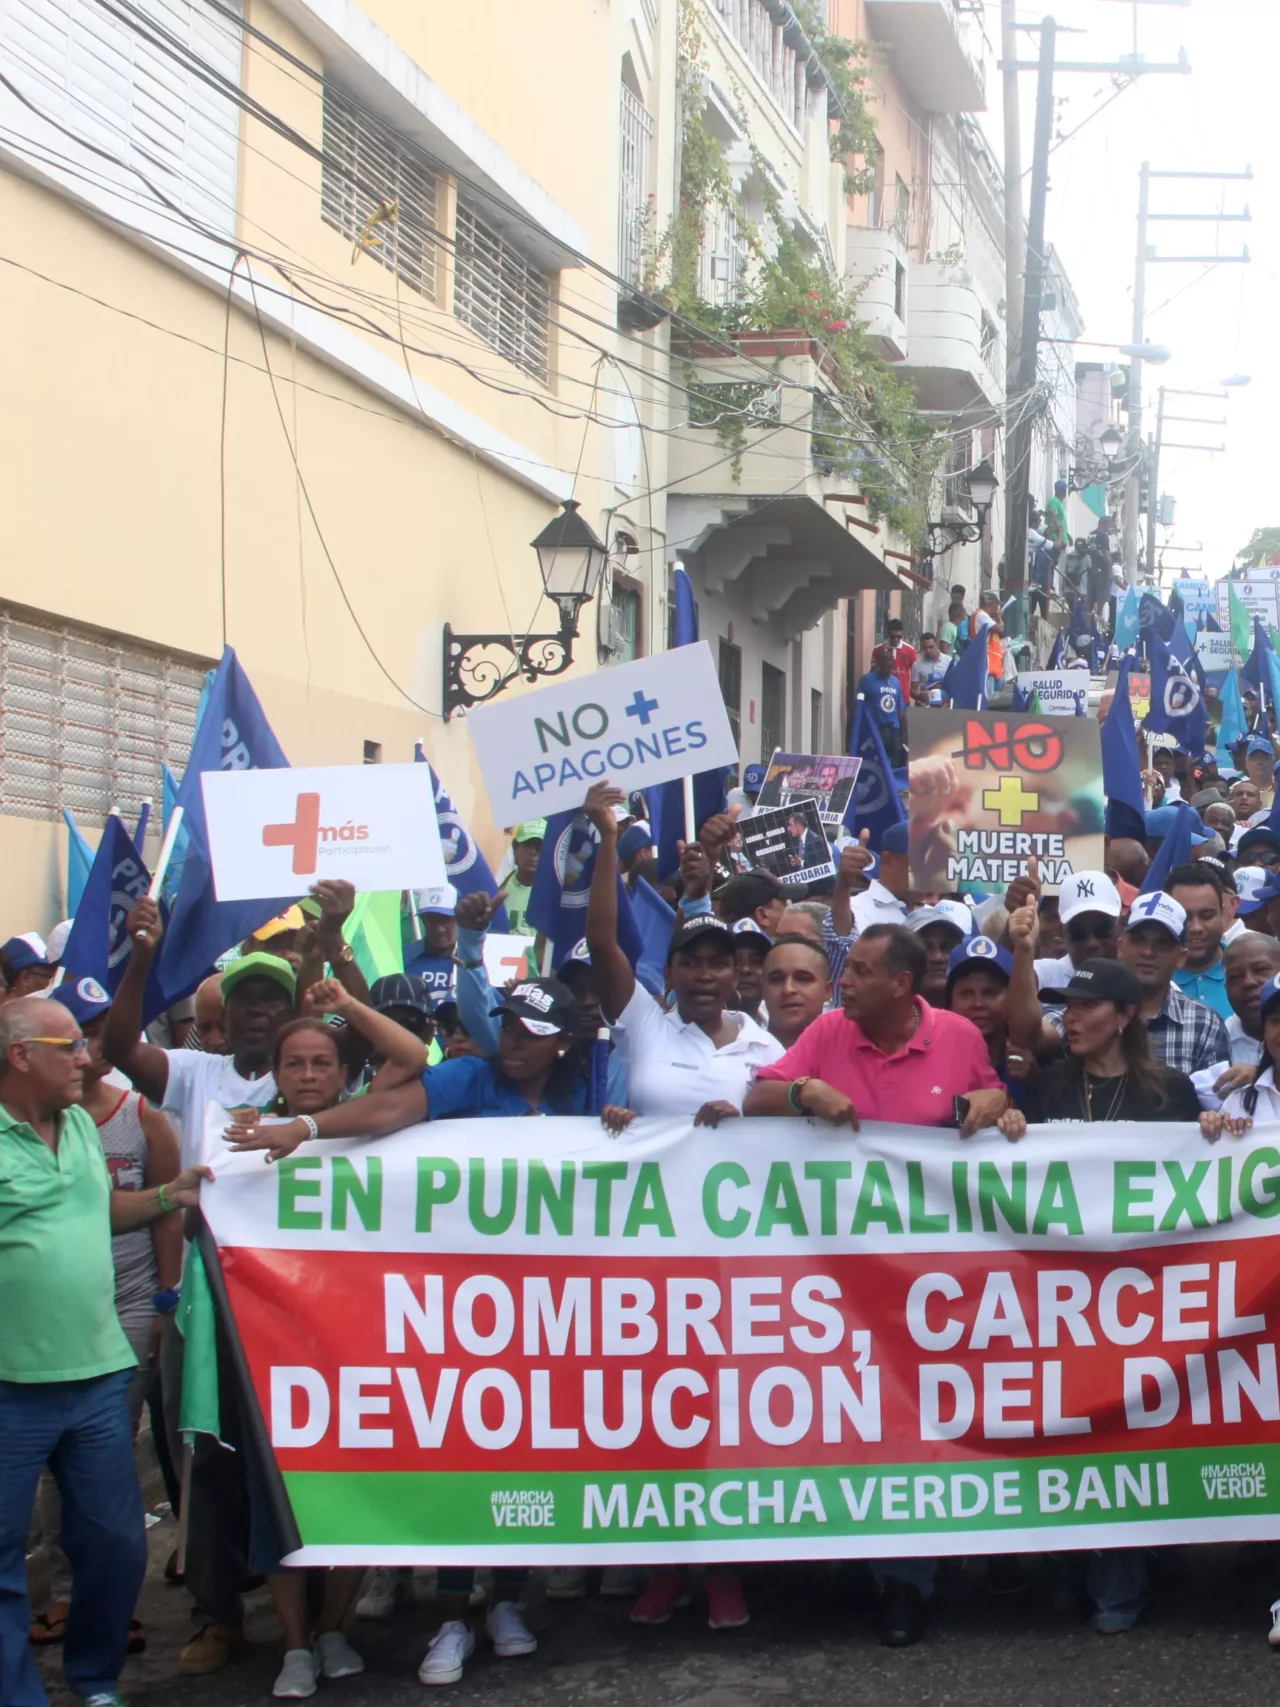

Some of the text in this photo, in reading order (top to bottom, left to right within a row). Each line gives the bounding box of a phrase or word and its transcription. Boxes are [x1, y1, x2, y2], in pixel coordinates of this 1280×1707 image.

[880, 686, 897, 695] PRM
[1033, 680, 1063, 690] SALUD
[533, 702, 609, 753] NO
[512, 720, 708, 800] APAGONES
[962, 718, 1065, 773] NO
[316, 820, 370, 842] más
[956, 829, 1065, 858] MUERTE
[276, 1156, 383, 1231] EN
[414, 1156, 677, 1238] PUNTA
[700, 1159, 1085, 1239] CATALINA
[383, 1272, 873, 1374] NOMBRES,
[905, 1260, 1267, 1352] CARCEL
[269, 1362, 883, 1450] DEVOLUCION
[918, 1360, 1092, 1442] DEL
[1200, 1462, 1266, 1479] #MARCHA
[490, 1490, 555, 1505] #MARCHA
[582, 1461, 1170, 1529] MARCHA VERDE BANI
[1202, 1476, 1268, 1500] VERDE
[491, 1504, 555, 1528] VERDE
